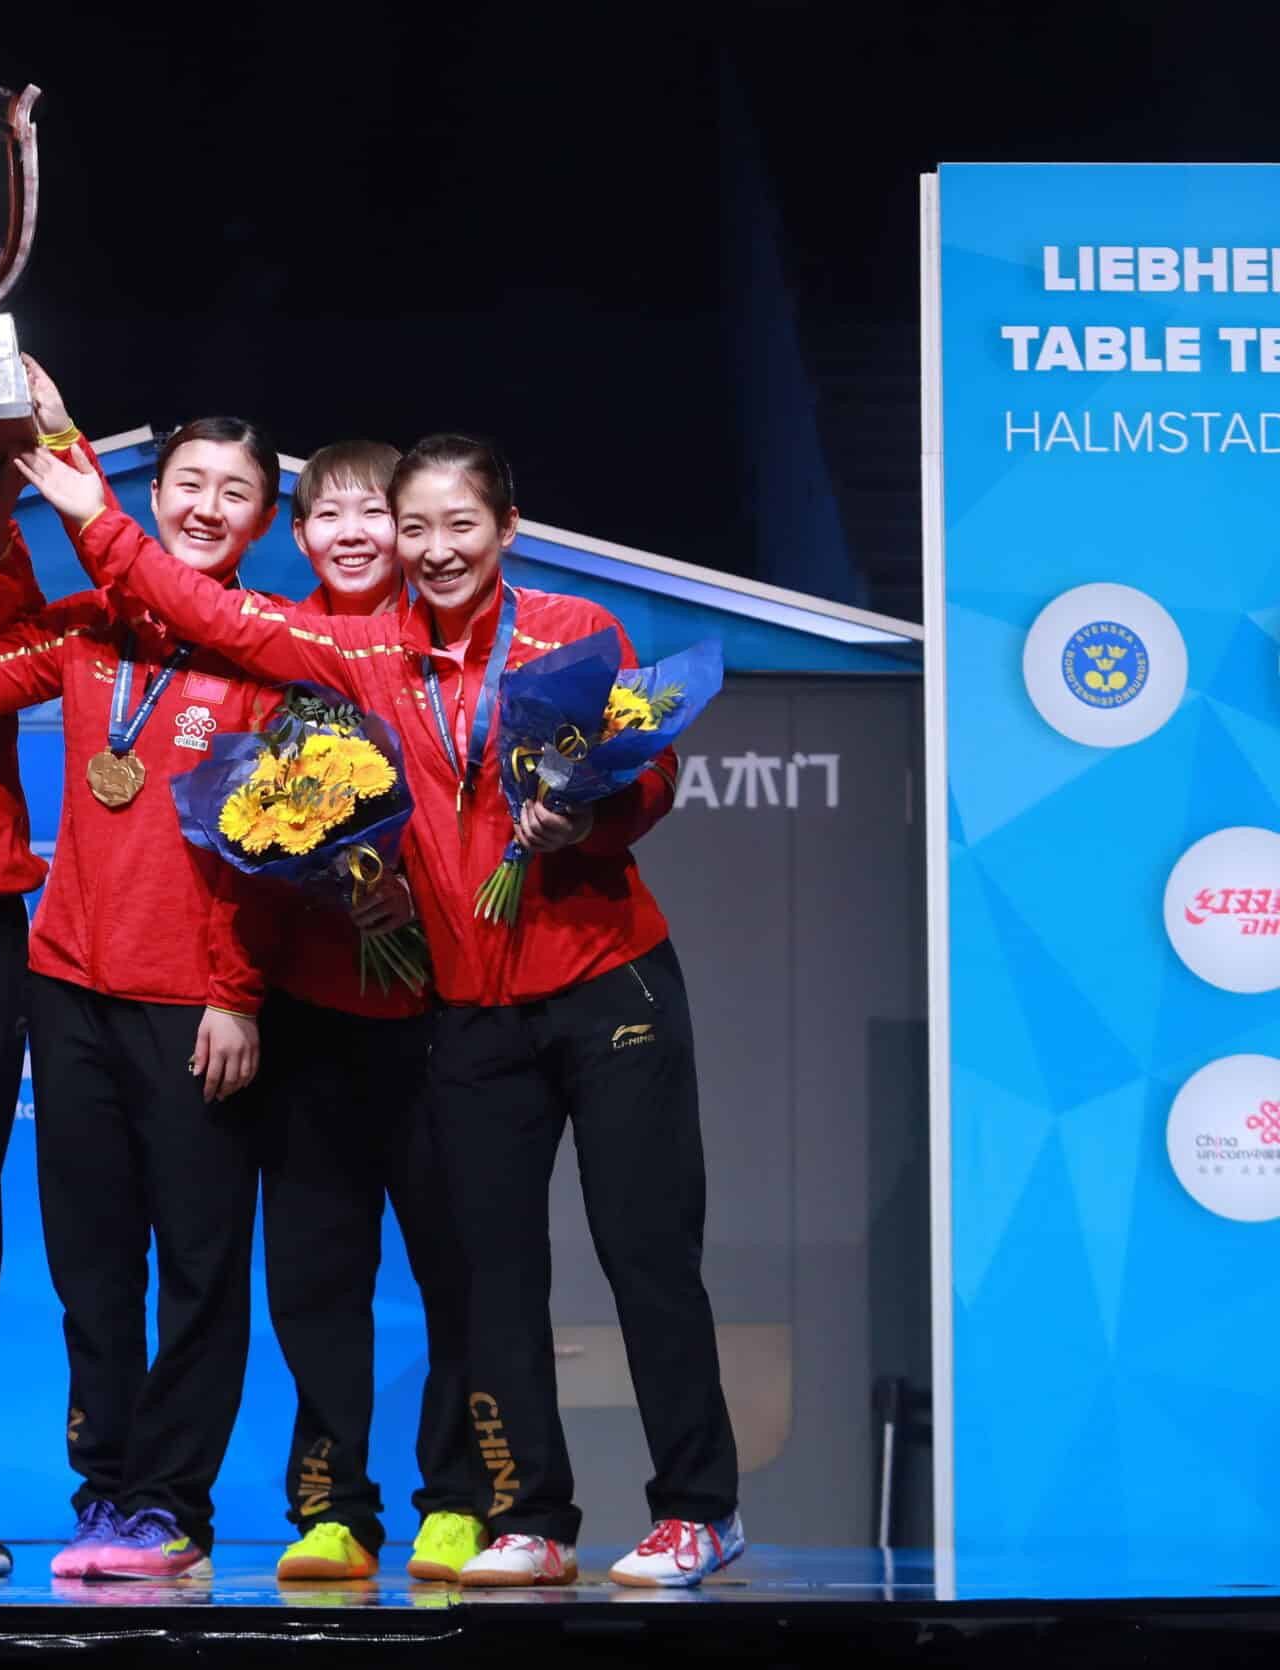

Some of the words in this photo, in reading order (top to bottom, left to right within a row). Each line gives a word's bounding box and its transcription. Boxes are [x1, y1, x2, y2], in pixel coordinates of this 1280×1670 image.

[1044, 246, 1280, 292] LIEBHE
[1000, 326, 1201, 372] TABLE
[1218, 327, 1280, 373] TE
[468, 1391, 521, 1519] CHINA
